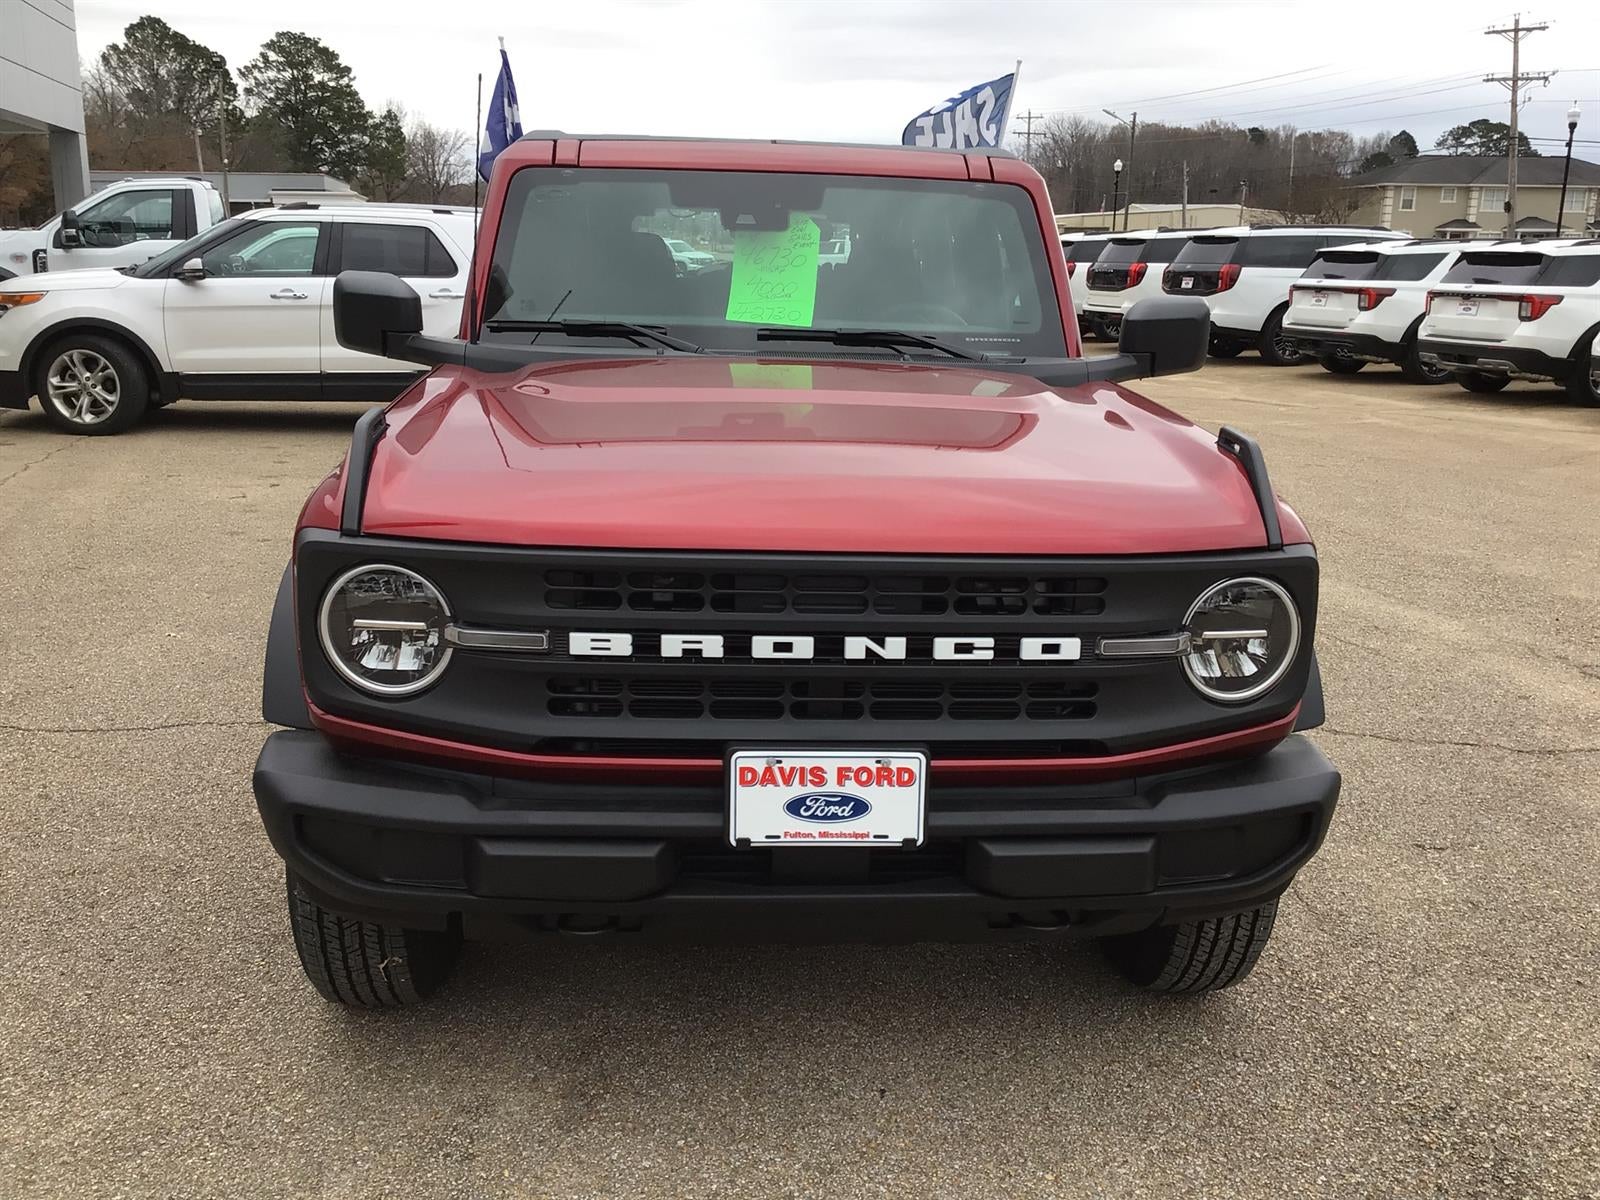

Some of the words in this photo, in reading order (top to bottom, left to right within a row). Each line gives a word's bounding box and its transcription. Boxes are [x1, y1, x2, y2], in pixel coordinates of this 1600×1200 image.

[741, 245, 807, 268] 46730
[744, 277, 799, 296] 4000
[733, 303, 802, 322] 42730
[569, 631, 1082, 661] BRONCO
[738, 766, 828, 787] DAVIS
[836, 766, 917, 788] FORD
[799, 796, 855, 817] Ford
[783, 831, 816, 839] Fulton,
[818, 831, 870, 840] Mississippi
